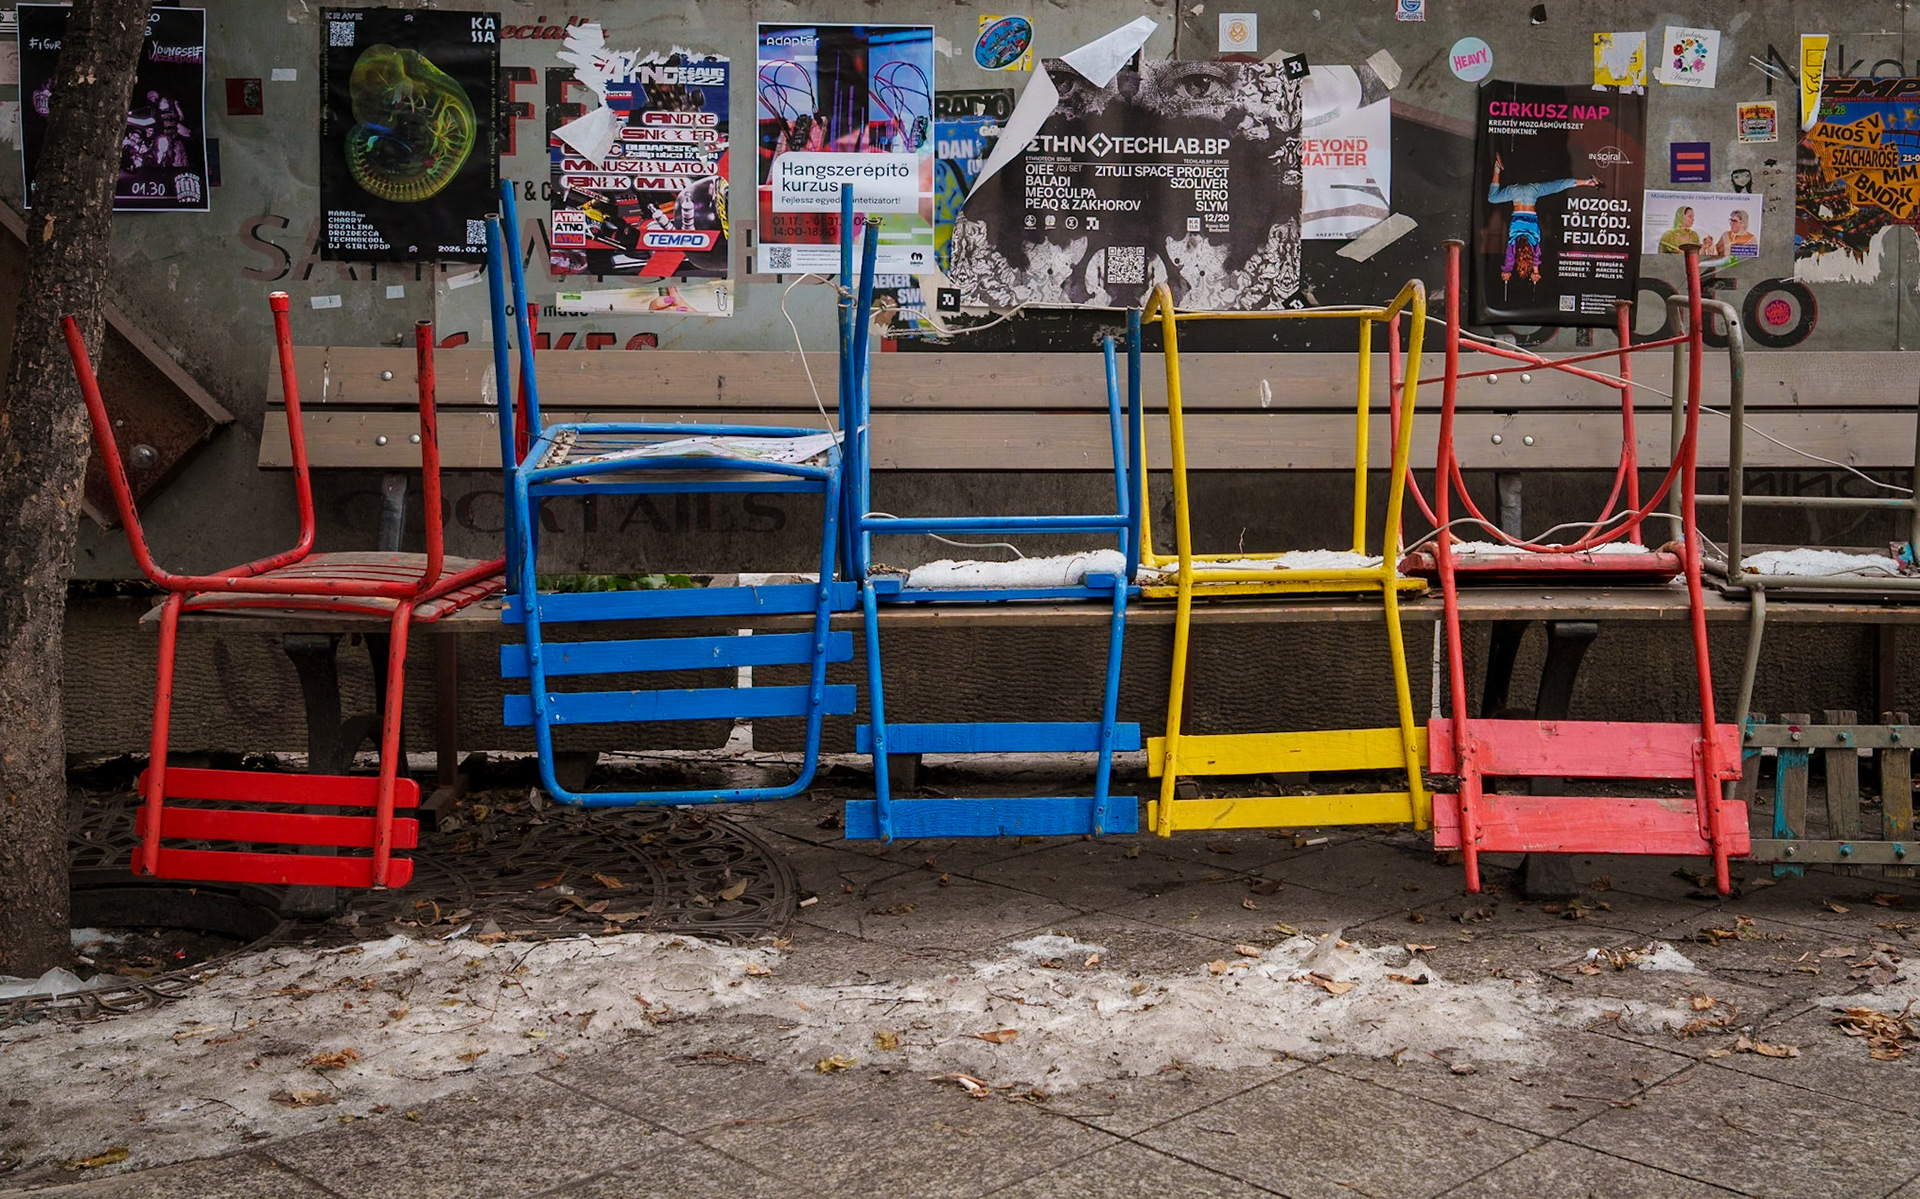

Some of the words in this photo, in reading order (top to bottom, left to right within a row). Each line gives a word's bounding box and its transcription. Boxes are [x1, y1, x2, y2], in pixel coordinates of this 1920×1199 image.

[472, 17, 495, 30] KA
[1675, 30, 1708, 41] Budapest
[1453, 47, 1487, 72] HEAVY
[1670, 71, 1702, 85] Hungary
[1489, 101, 1568, 119] CIRKUSZ
[1573, 105, 1610, 120] NAP
[1835, 105, 1847, 115] 28
[1489, 119, 1518, 128] KREATÍV
[1488, 127, 1538, 136] MINDENKINEK
[1868, 131, 1880, 144] V
[1302, 139, 1368, 152] BEYOND
[1302, 153, 1367, 166] MATTER
[782, 162, 909, 180] Hangszerépítő
[1025, 164, 1054, 175] OIEE
[1095, 166, 1132, 177] ZITULI
[1134, 166, 1174, 177] SPACE
[1177, 167, 1230, 178] PROJECT
[1883, 165, 1918, 184] MM
[782, 178, 838, 192] kurzus
[1026, 176, 1071, 187] BALADI
[1170, 178, 1228, 189] SZOLIVER
[132, 182, 165, 196] 01.30
[1026, 187, 1053, 198] MEO
[1056, 188, 1096, 199] CULPA
[1195, 190, 1228, 200] ERRO
[1854, 174, 1907, 215] BNDK
[781, 196, 813, 205] Fejlessz
[815, 196, 842, 205] egyed
[1026, 199, 1058, 210] PEAQ
[1061, 199, 1070, 210] &
[1072, 199, 1141, 211] ZAKHOROV
[1196, 201, 1228, 212] SLYM
[1567, 198, 1631, 212] MOZOGJ.
[554, 212, 584, 222] ATNO
[1204, 214, 1230, 222] 12/20
[1561, 212, 1631, 229] TÖLTŐDJ.
[554, 224, 584, 232] ATNO
[649, 234, 704, 246] TEMPO
[1563, 229, 1630, 246] FEJLŐDJ.
